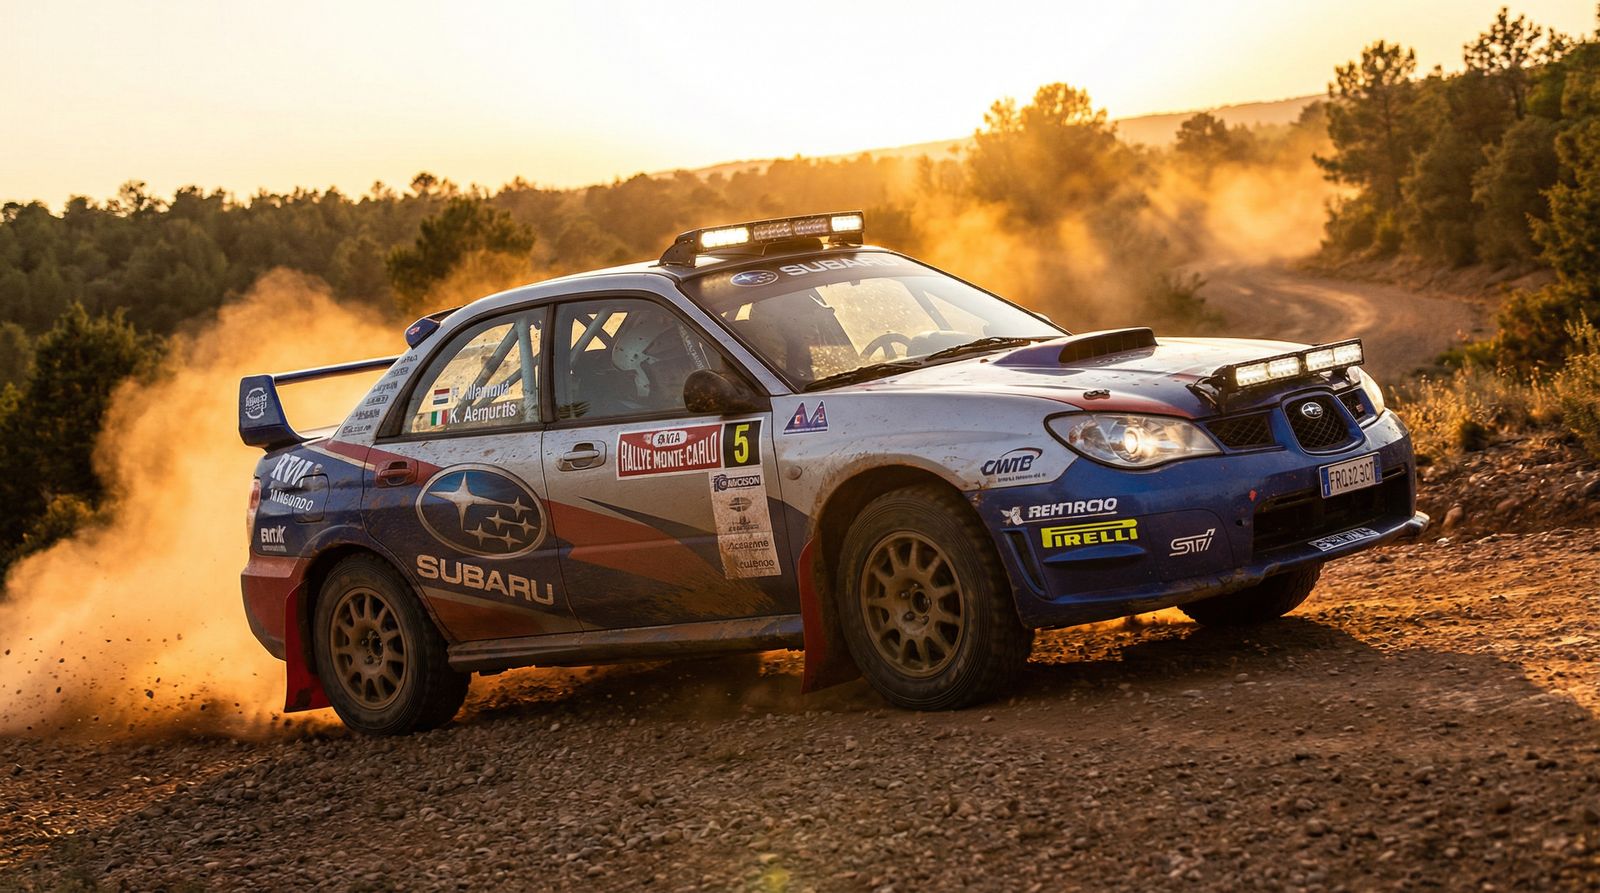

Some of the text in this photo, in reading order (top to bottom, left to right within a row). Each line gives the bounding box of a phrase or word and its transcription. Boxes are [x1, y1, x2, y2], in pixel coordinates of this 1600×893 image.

[780, 257, 900, 276] SUBARU
[449, 407, 460, 424] K.
[621, 440, 652, 472] RALLYE
[734, 424, 750, 464] 5
[1040, 518, 1138, 549] PIRELLI
[416, 554, 554, 606] SUBARU
